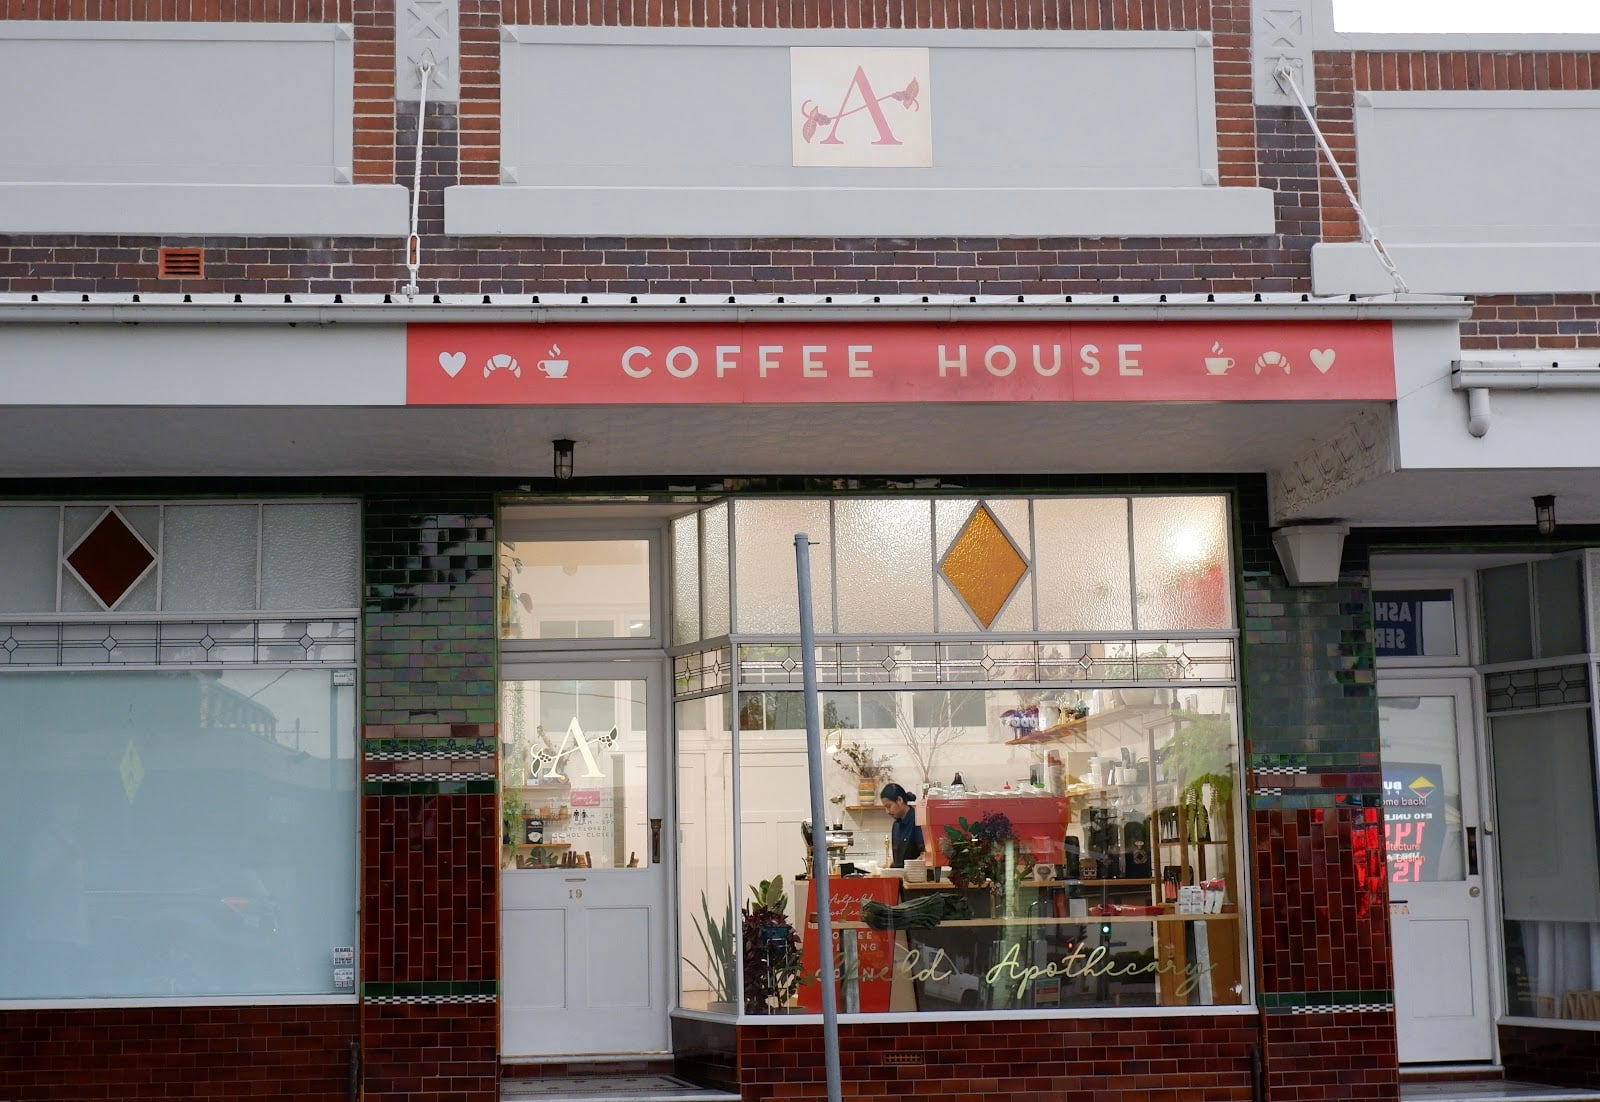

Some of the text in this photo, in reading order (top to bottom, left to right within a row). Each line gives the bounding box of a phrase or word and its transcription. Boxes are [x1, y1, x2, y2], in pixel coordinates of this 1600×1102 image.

[819, 65, 903, 145] A
[621, 343, 1144, 379] COFFEE HOUSE
[543, 716, 606, 778] A
[568, 889, 583, 899] 19
[985, 942, 1218, 1000] Apothecary
